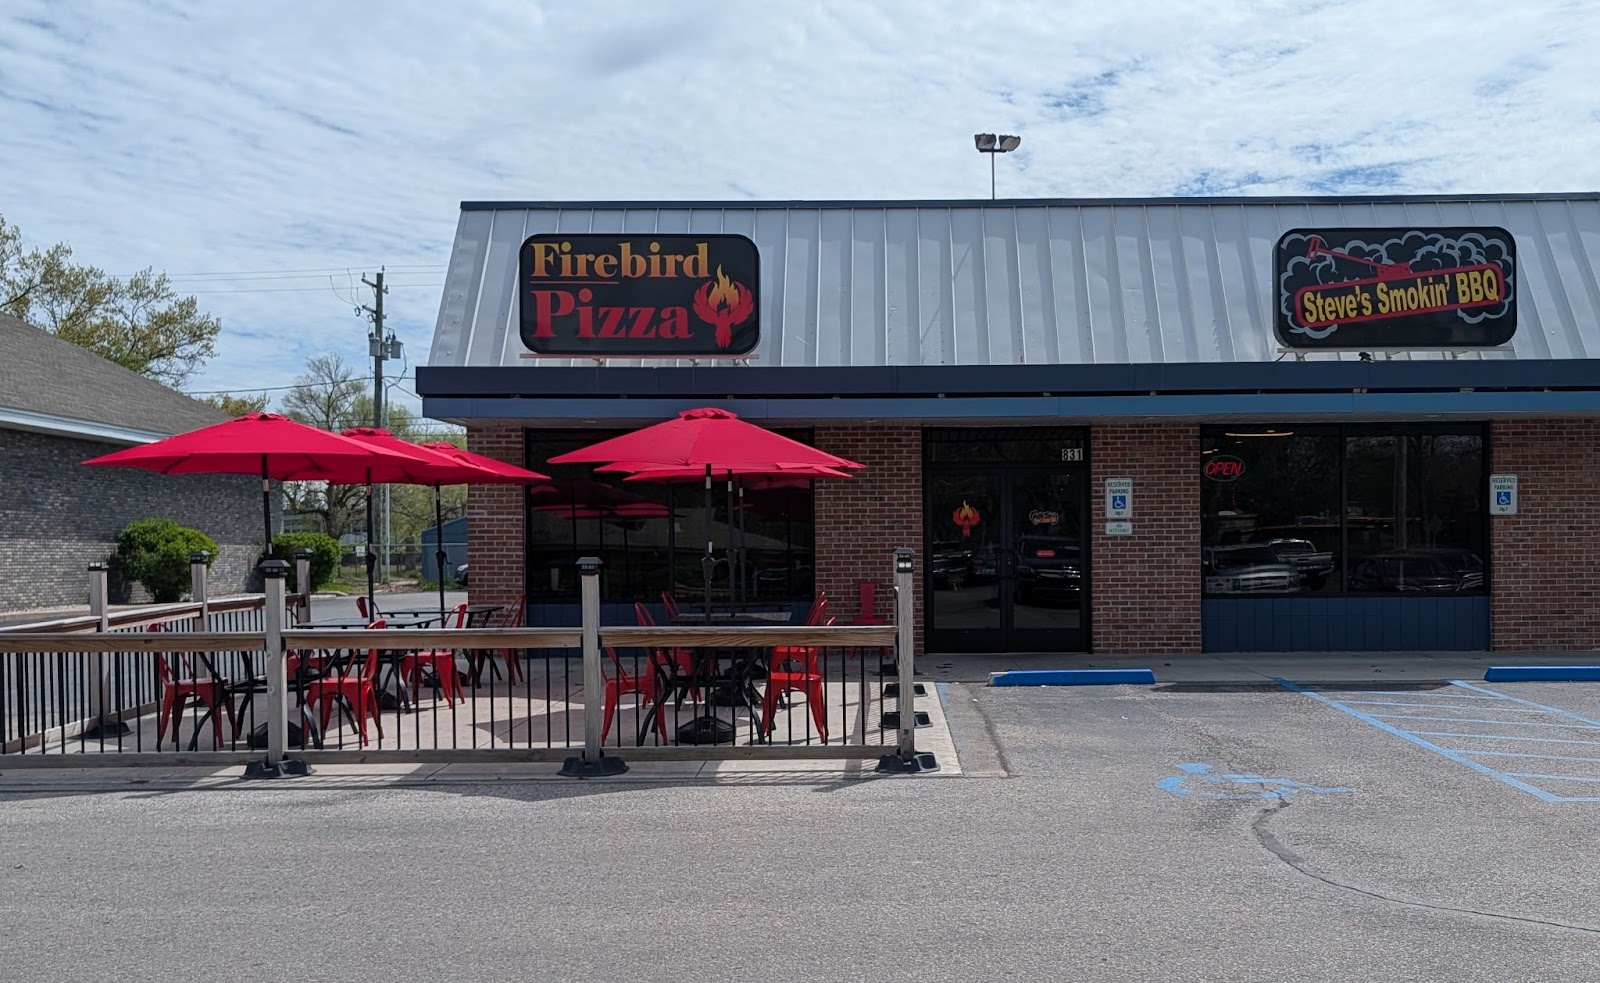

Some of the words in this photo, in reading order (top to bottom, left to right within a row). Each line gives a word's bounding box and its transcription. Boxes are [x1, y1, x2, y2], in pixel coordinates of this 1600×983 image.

[531, 241, 711, 278] Firebird
[531, 288, 694, 339] Pizza
[1303, 286, 1373, 323] Steve's
[1376, 275, 1450, 314] Smokin'
[1455, 269, 1499, 304] BBQ
[1063, 449, 1081, 460] 831
[1205, 461, 1242, 476] OPEN
